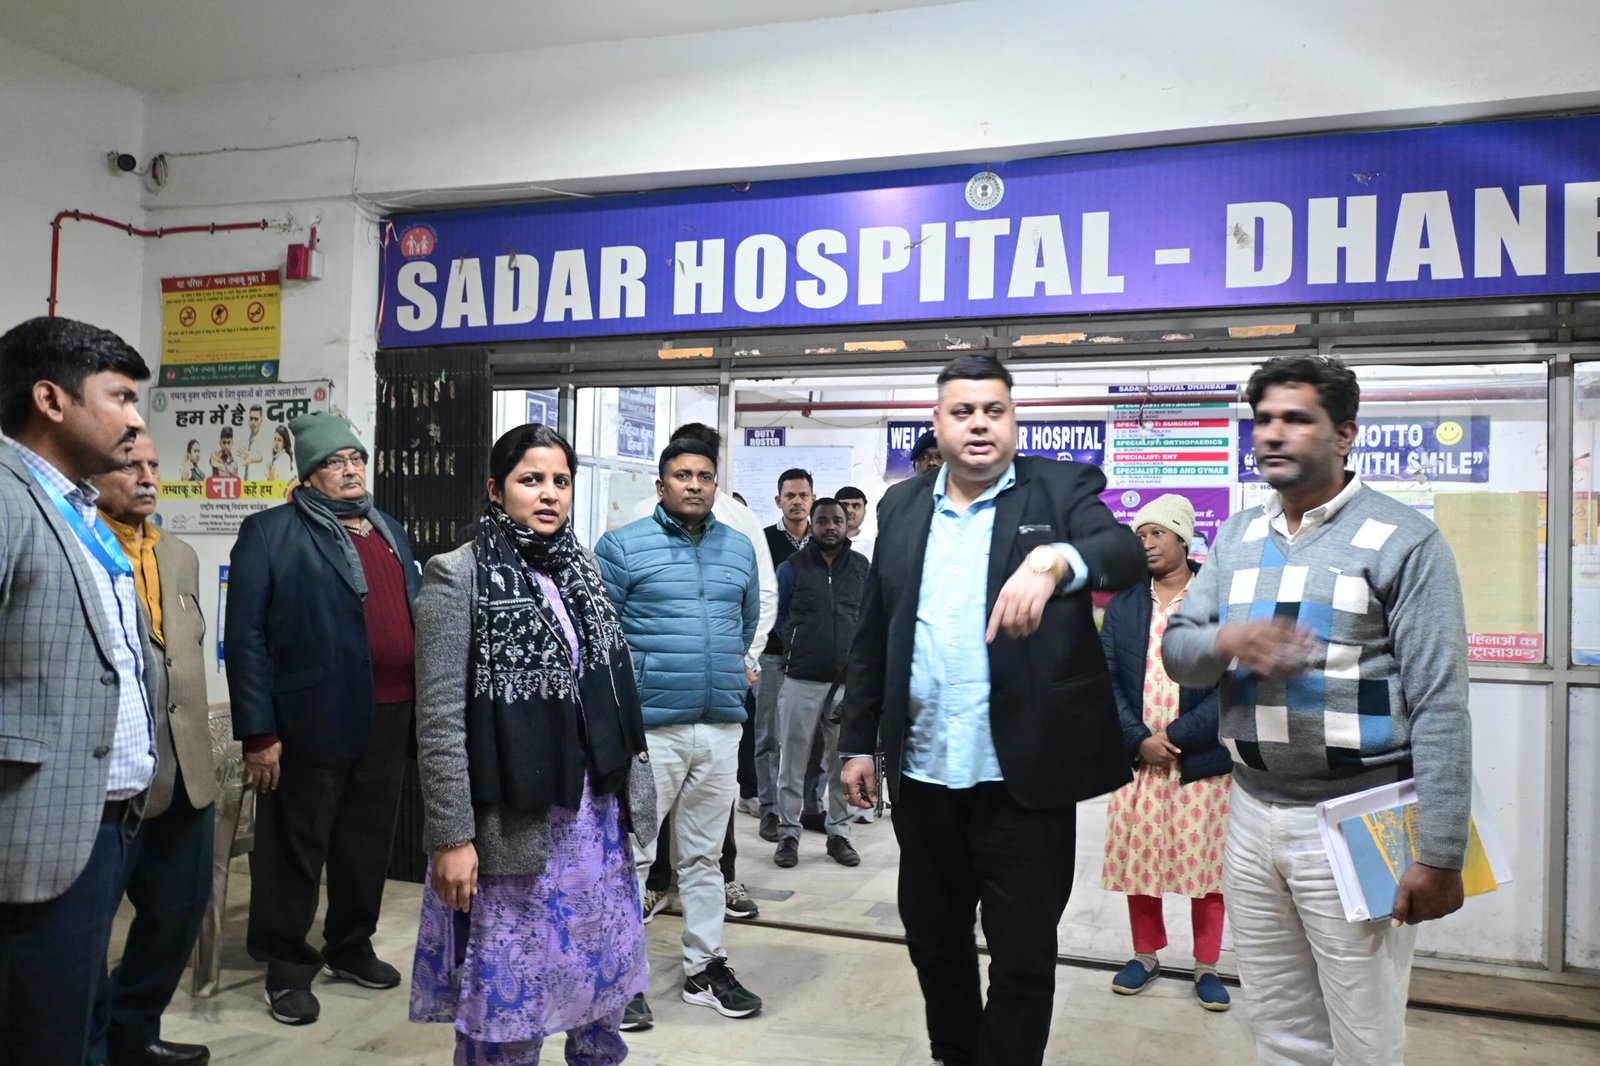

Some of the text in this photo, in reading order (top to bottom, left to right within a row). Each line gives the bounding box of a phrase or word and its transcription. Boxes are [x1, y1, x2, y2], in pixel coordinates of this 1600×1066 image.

[396, 245, 647, 332] SADAR
[673, 211, 1125, 315] HOSPITAL
[1155, 247, 1190, 265] -
[176, 410, 205, 427] हम
[209, 403, 229, 425] में
[231, 403, 246, 426] है
[750, 437, 780, 446] ROSTER
[754, 429, 776, 438] DUTY
[1031, 426, 1102, 450] HOSPITAL
[1352, 424, 1423, 448] MOTTO
[1345, 452, 1400, 475] WITH
[162, 484, 191, 499] तम्बाकू
[191, 482, 203, 495] को
[211, 477, 238, 498] ना
[260, 484, 272, 498] हम
